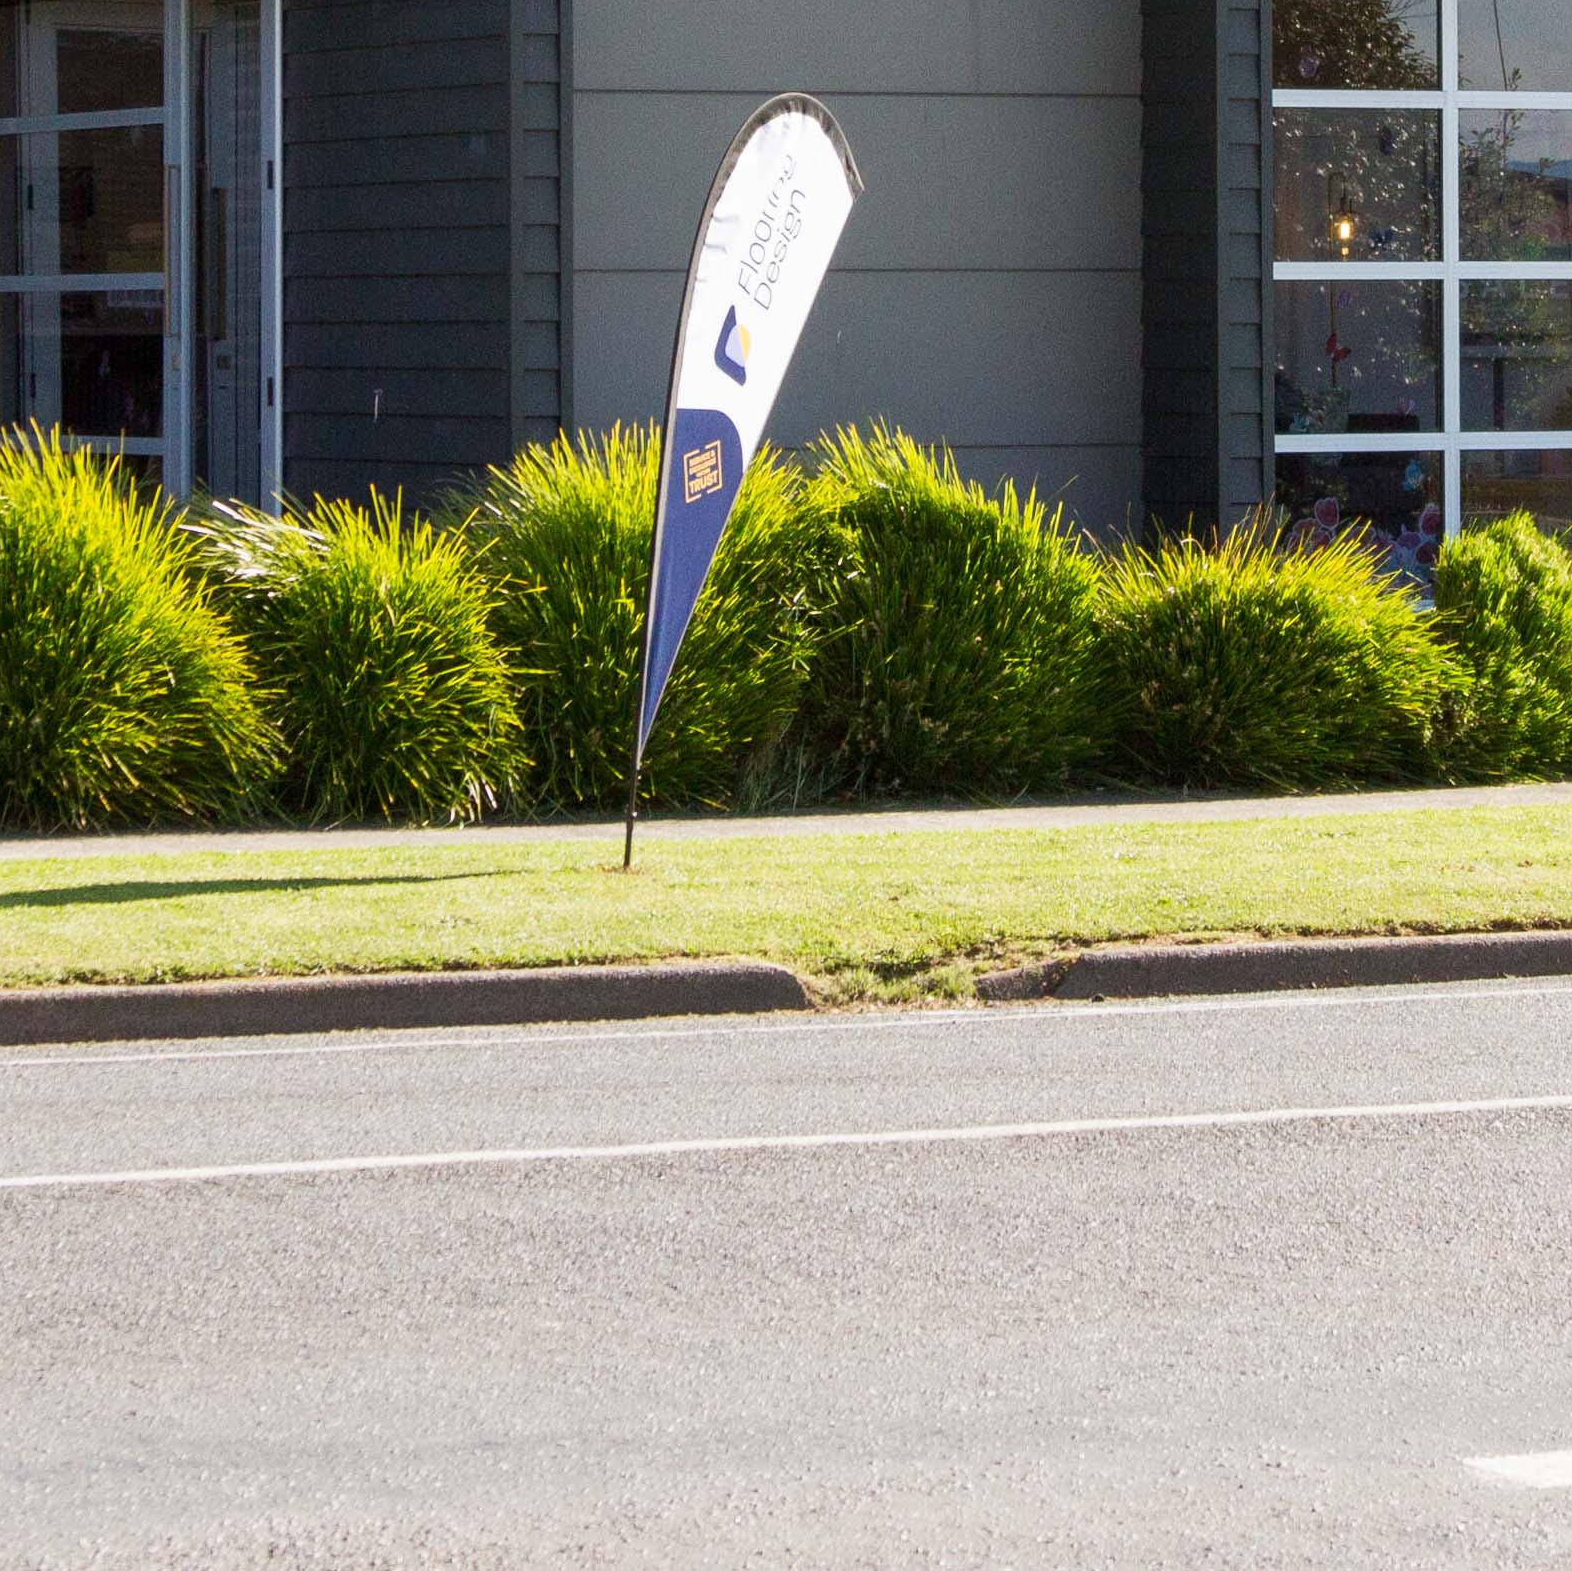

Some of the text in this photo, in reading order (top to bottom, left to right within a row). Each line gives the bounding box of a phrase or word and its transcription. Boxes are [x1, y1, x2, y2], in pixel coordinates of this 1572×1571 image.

[738, 153, 798, 296] Flooring
[753, 188, 806, 311] Design
[688, 470, 718, 494] TRUST
